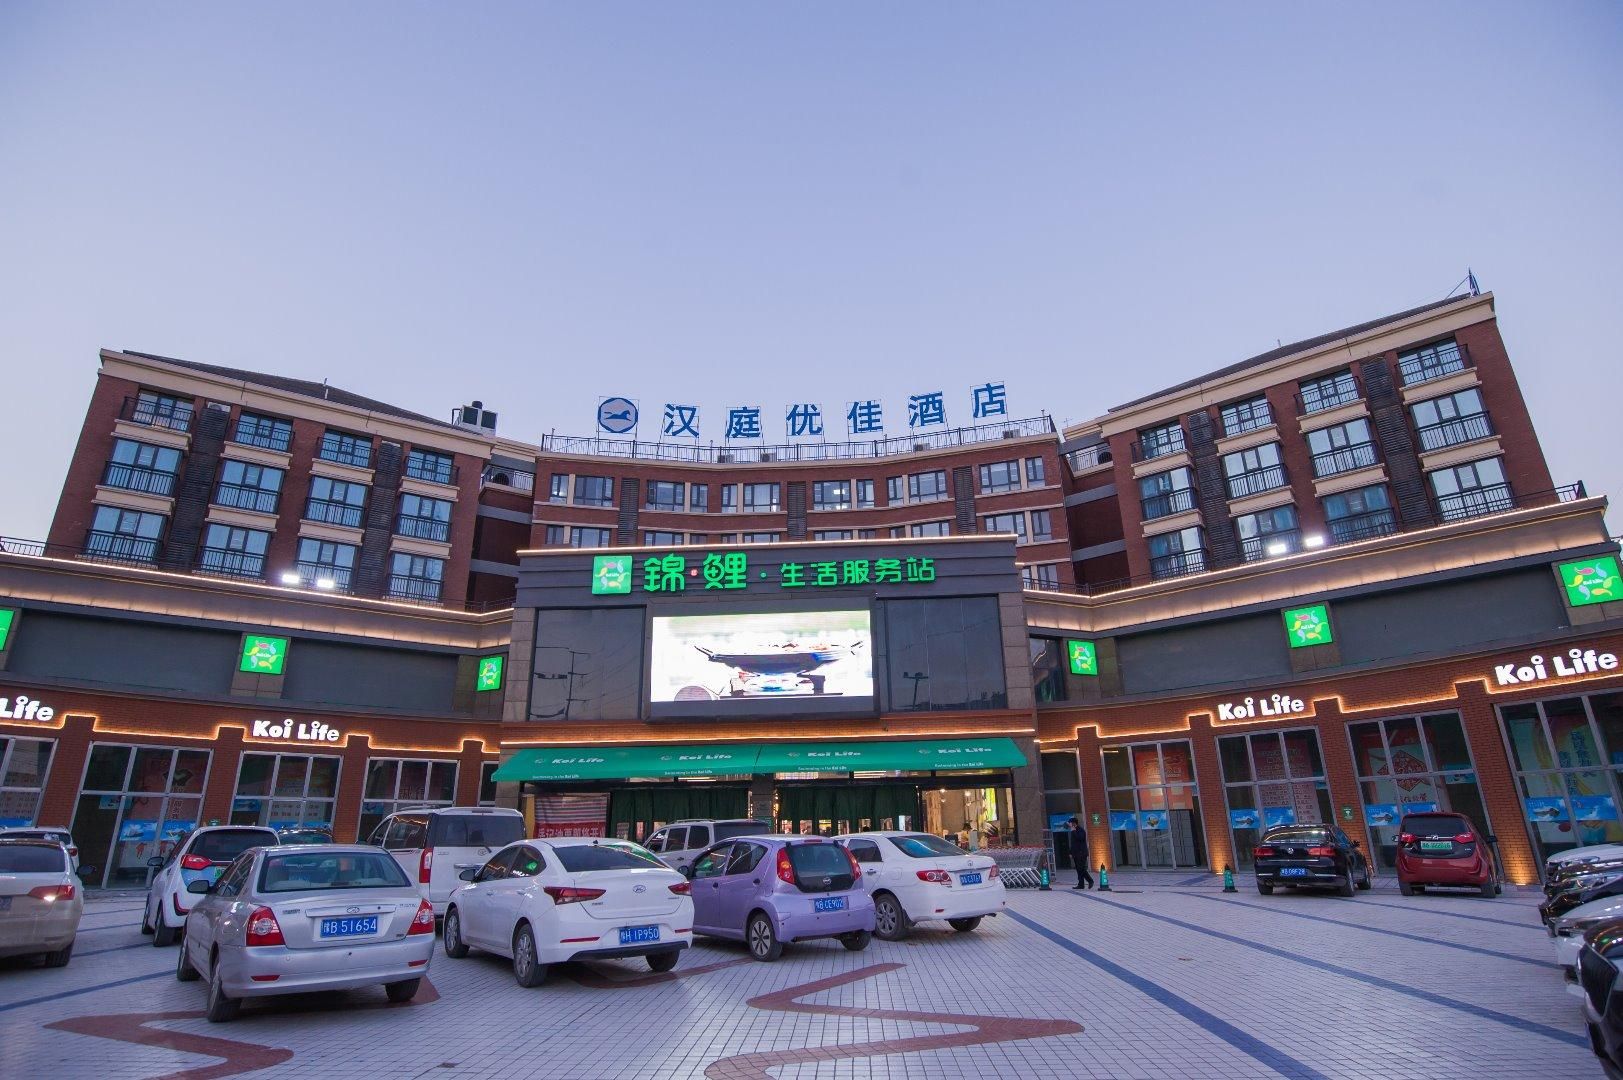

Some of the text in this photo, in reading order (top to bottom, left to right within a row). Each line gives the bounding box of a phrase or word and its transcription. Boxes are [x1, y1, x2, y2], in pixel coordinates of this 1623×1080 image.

[663, 382, 1006, 439] 汉庭优佳酒店
[1495, 648, 1618, 685] Koi Life
[0, 696, 54, 721] Life
[1217, 694, 1304, 720] Koi Life
[253, 718, 340, 741] Koi Life
